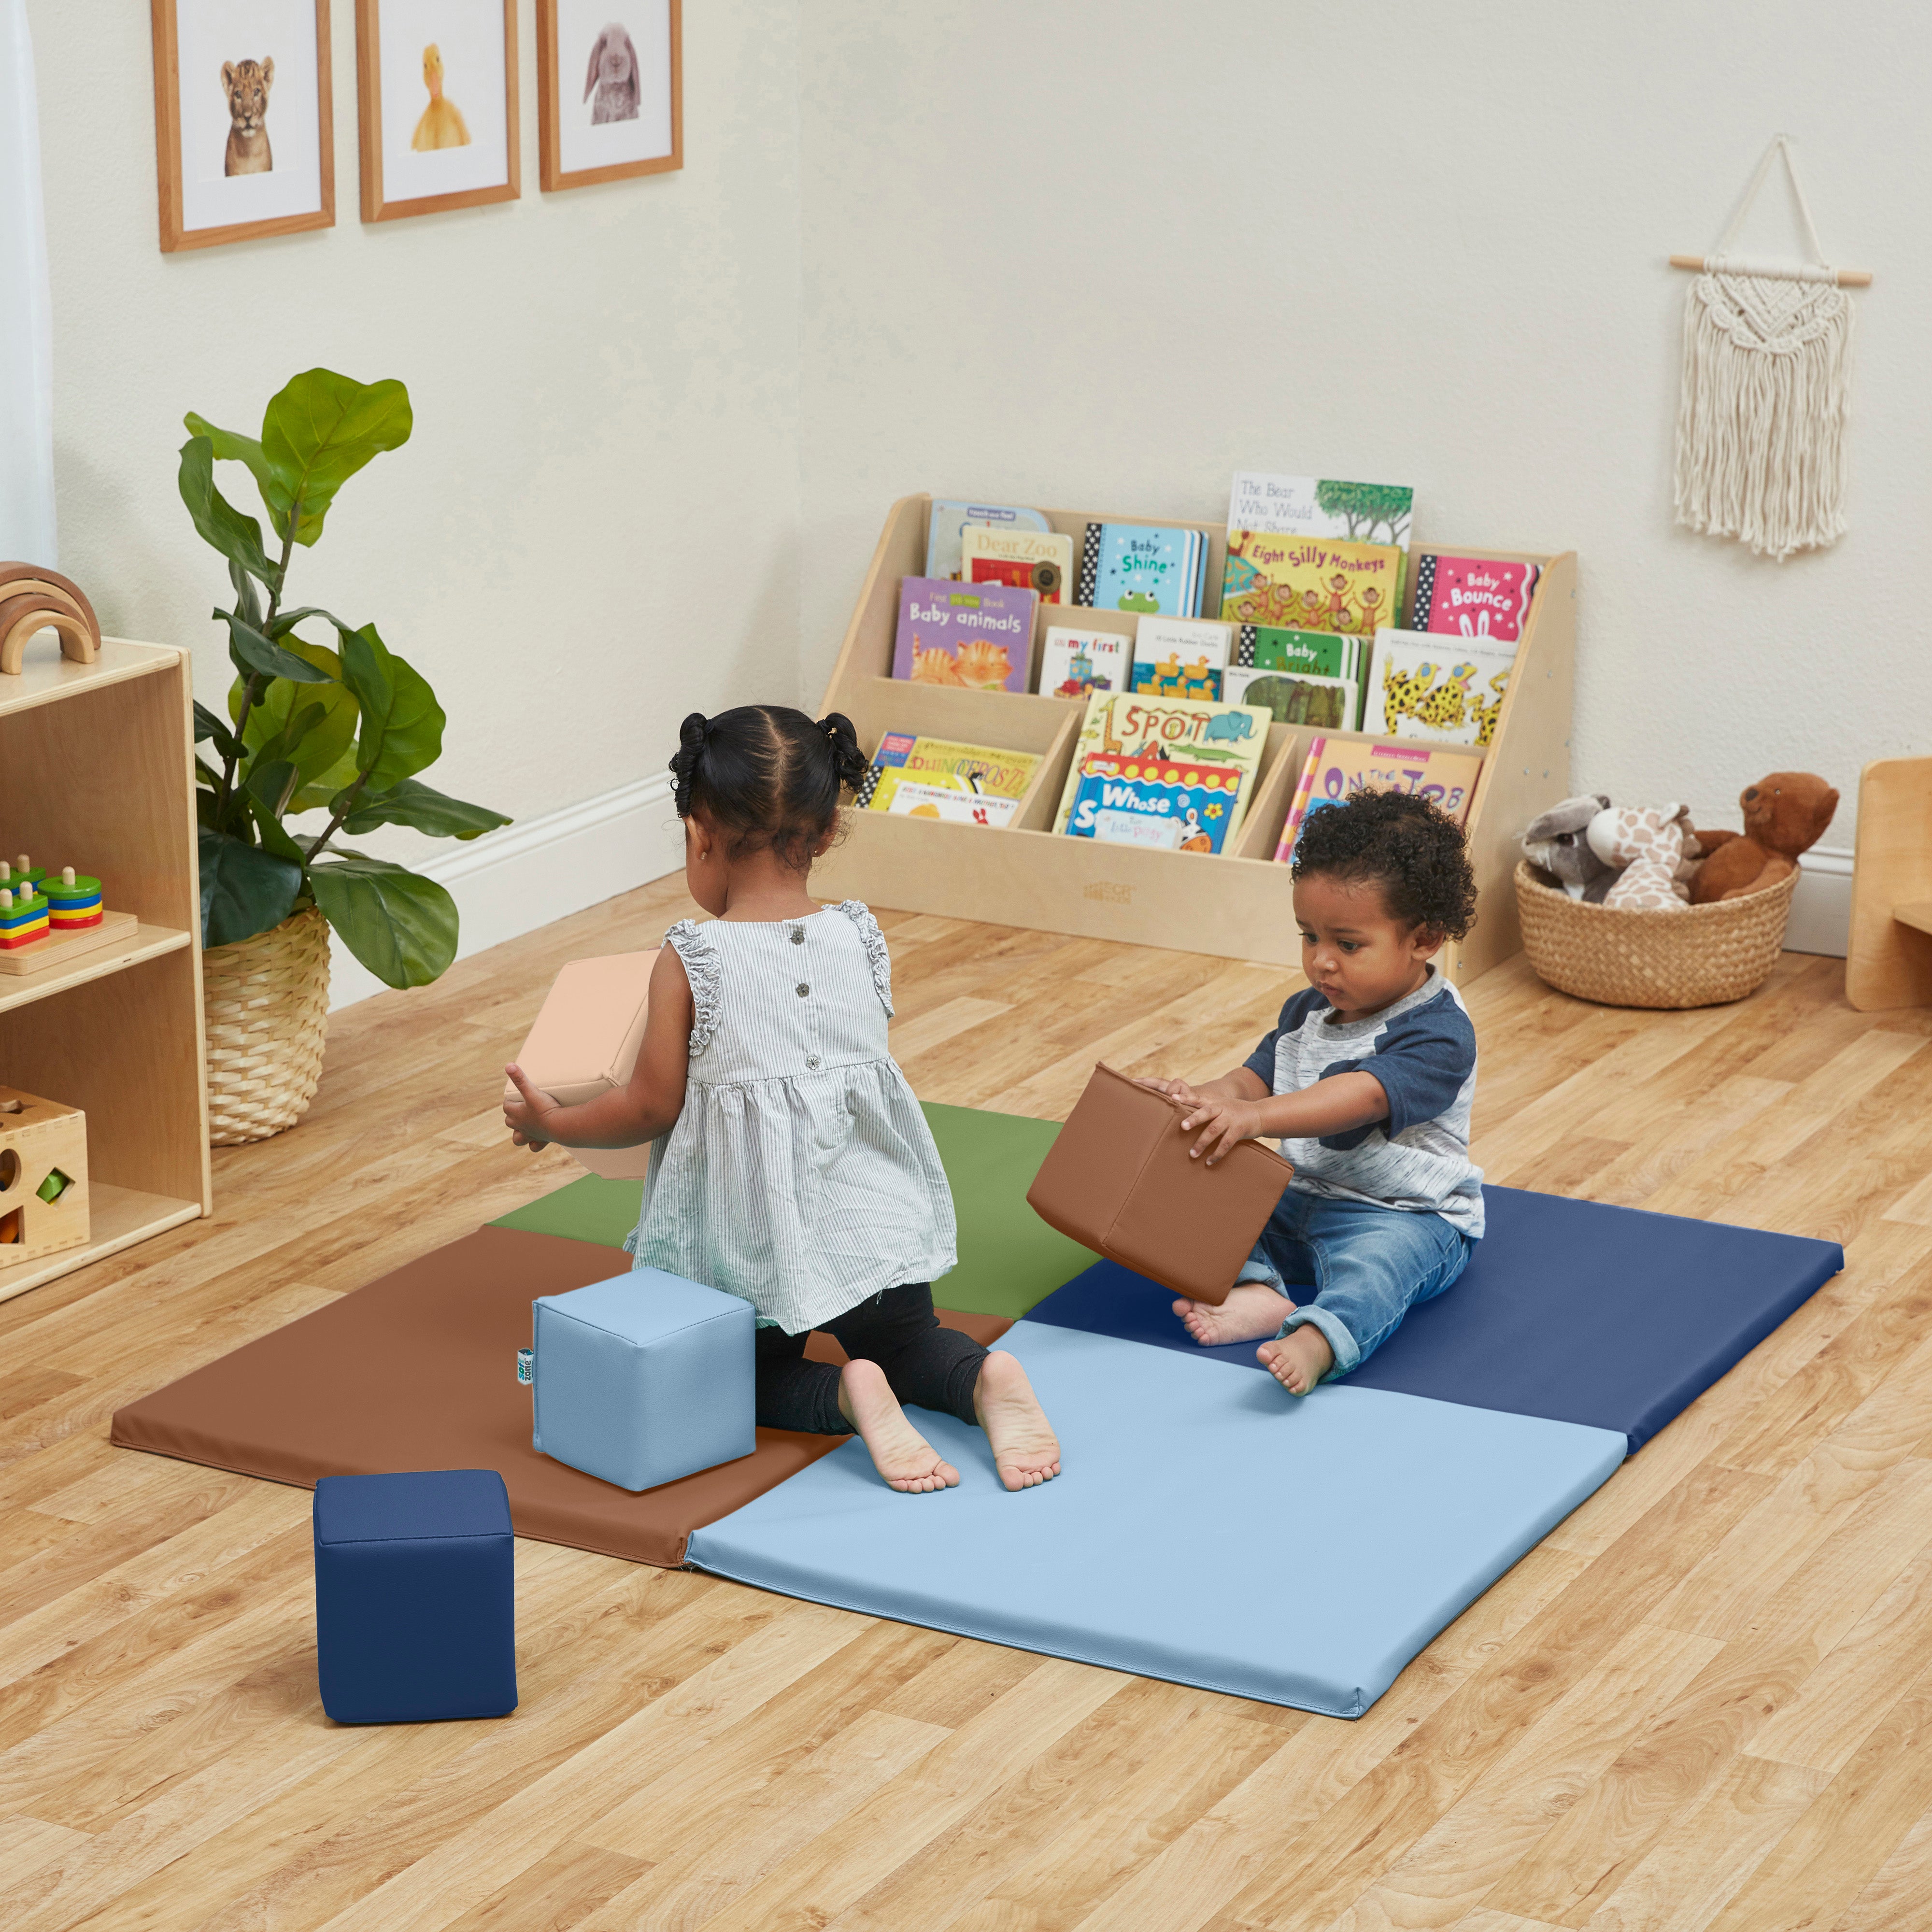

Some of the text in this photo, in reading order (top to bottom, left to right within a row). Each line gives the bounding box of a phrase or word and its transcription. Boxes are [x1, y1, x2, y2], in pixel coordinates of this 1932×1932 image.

[1242, 480, 1295, 499] The Bear
[1239, 499, 1313, 520] Who Would
[1264, 521, 1298, 535] Share
[977, 534, 1058, 558] Dear Zoo
[1131, 539, 1160, 555] Baby
[1122, 554, 1167, 573] Shine
[1252, 545, 1385, 573] Eight Silly Monkeys
[1467, 572, 1500, 592] Baby
[1450, 587, 1513, 611] Bounce
[909, 602, 1022, 633] Baby animals
[1068, 639, 1088, 653] my
[1093, 638, 1120, 653] first
[1285, 642, 1318, 662] Baby
[1276, 656, 1331, 676] Bright
[1122, 707, 1211, 741] SPOT
[1325, 767, 1464, 809] ON THE JOB
[1102, 783, 1171, 814] Whose
